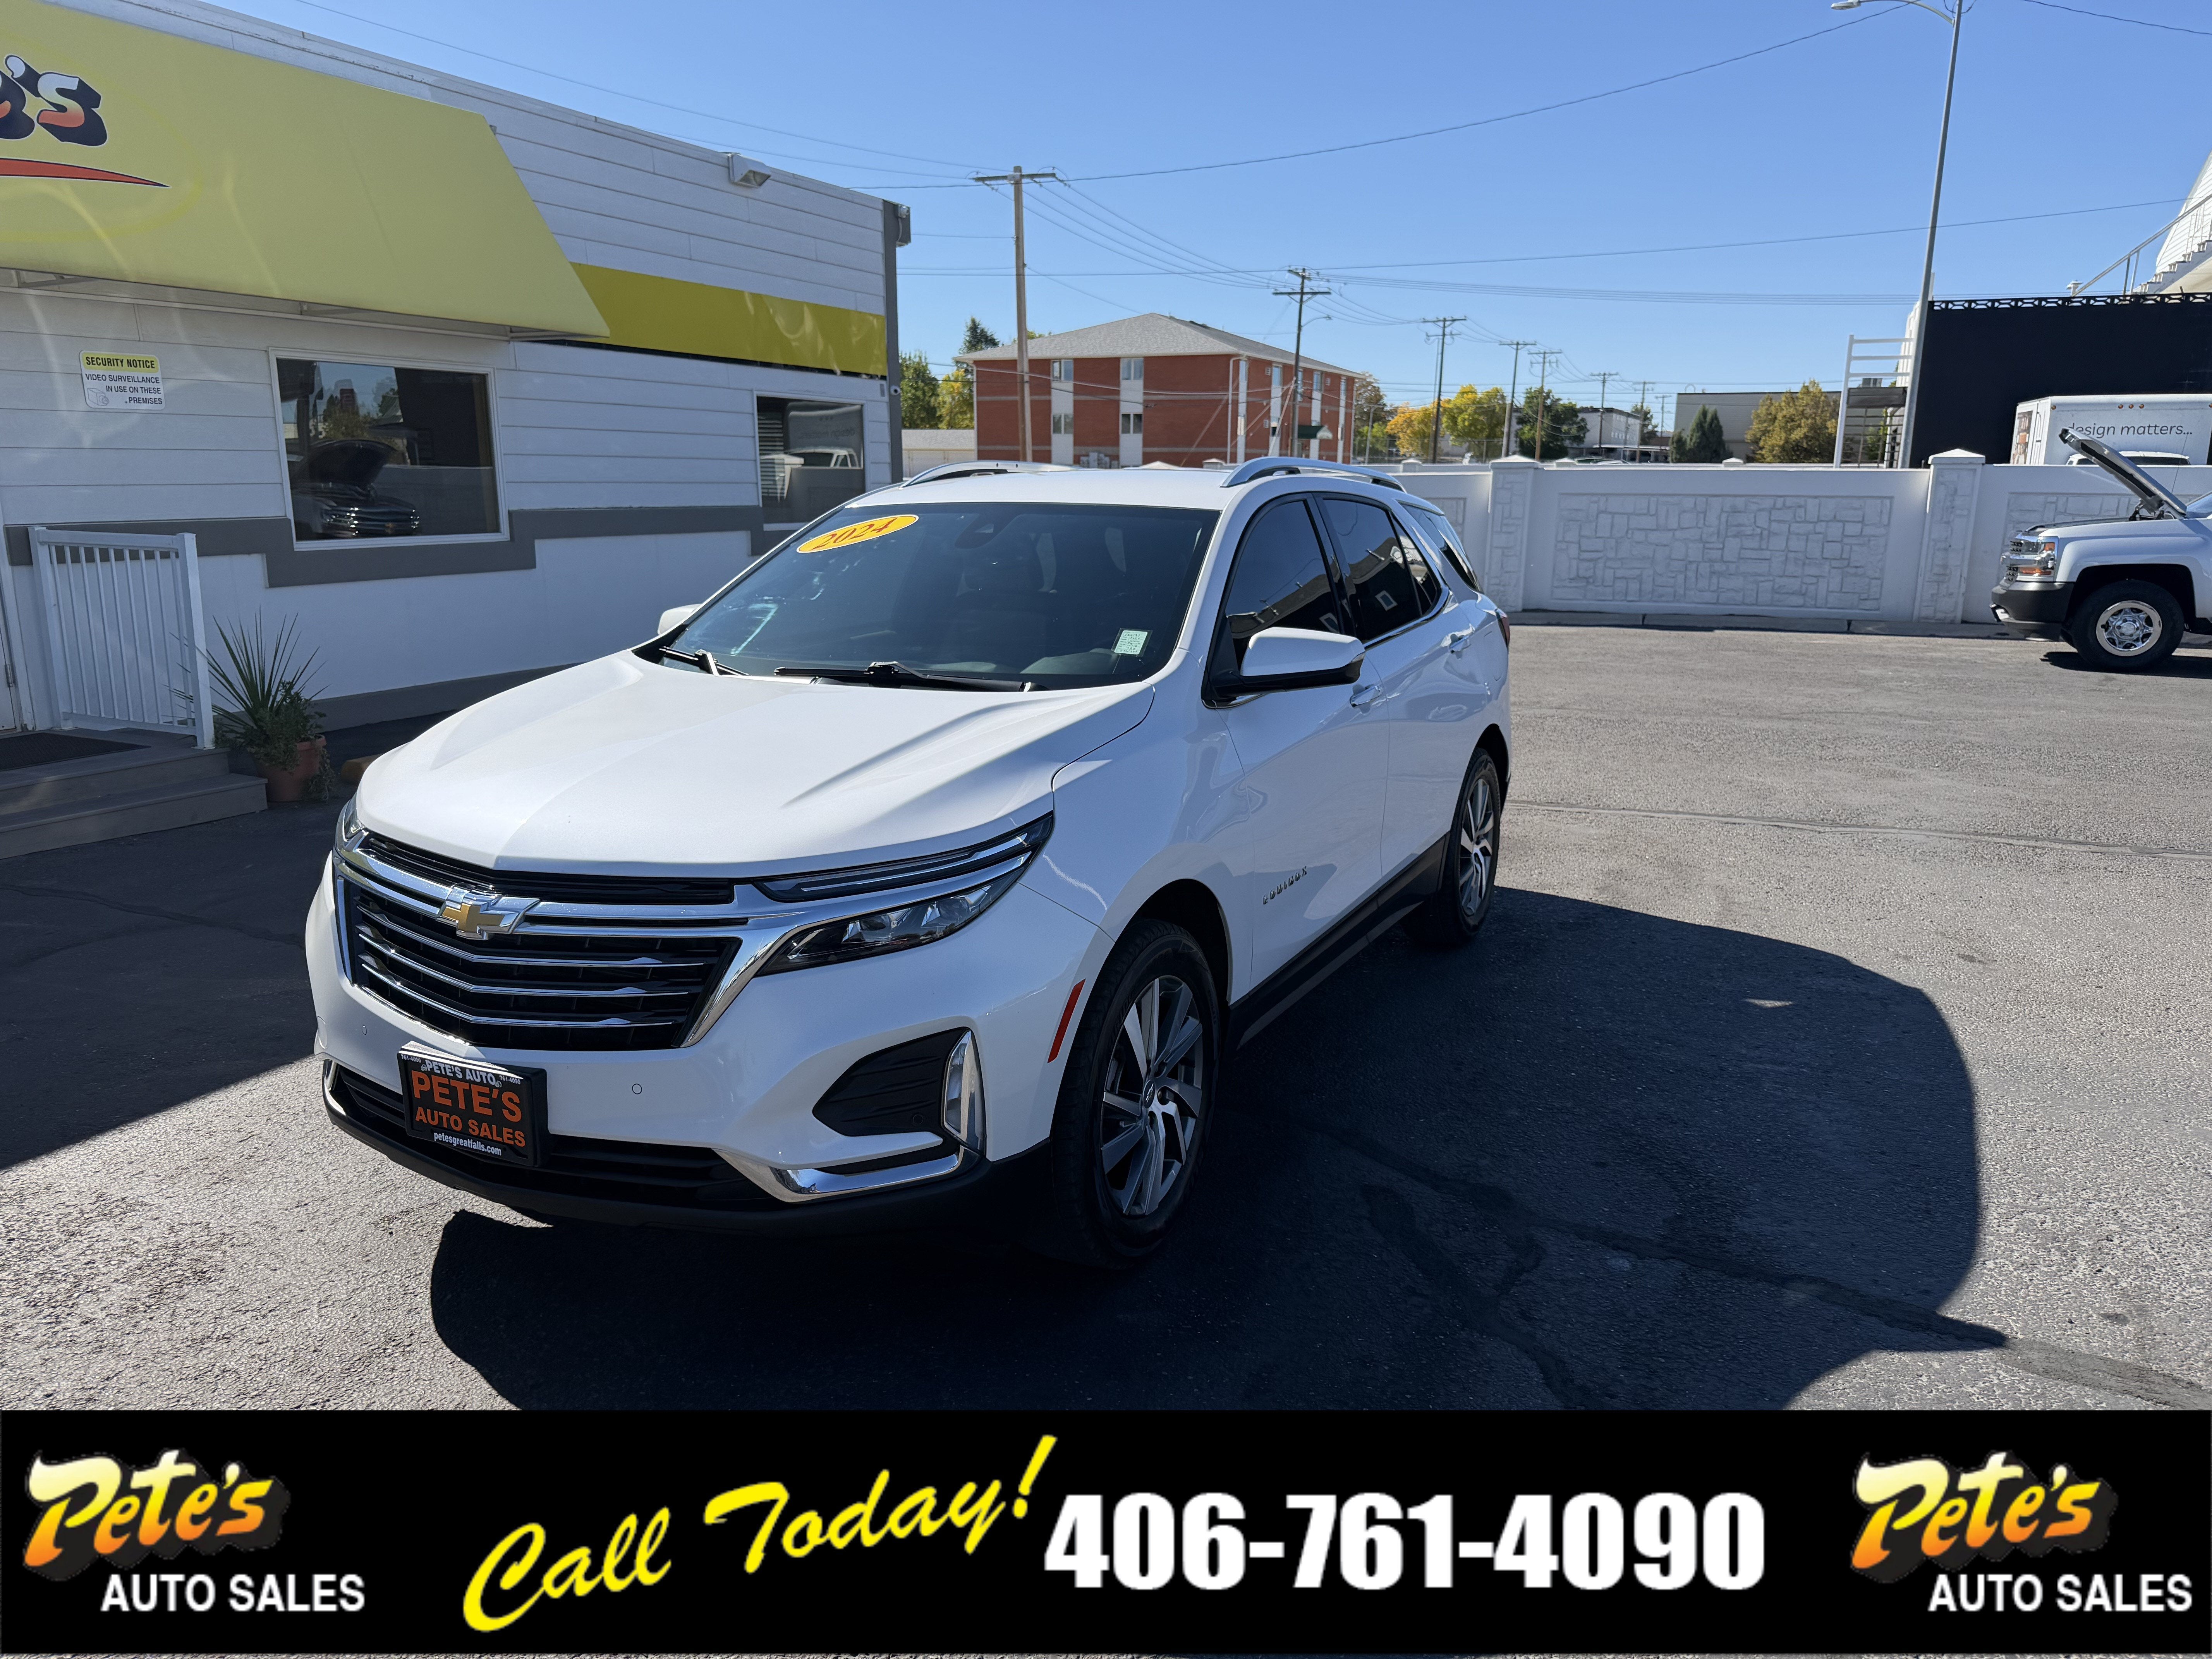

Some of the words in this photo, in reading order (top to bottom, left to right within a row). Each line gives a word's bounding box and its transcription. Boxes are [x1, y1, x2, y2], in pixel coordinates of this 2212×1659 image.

[86, 356, 124, 367] SECURITY
[127, 359, 155, 369] NOTICE
[108, 374, 160, 384] SURVEILLANCE
[812, 517, 898, 550] 2024
[1263, 866, 1307, 905] EQUINOX
[400, 1054, 421, 1063] 761-4090
[425, 1060, 463, 1079] PETE'S
[466, 1070, 496, 1085] AUTO
[499, 1075, 521, 1085] 761-4090
[411, 1070, 522, 1122] PETE'S
[415, 1107, 462, 1132] AUTO
[468, 1119, 526, 1147] SALES
[434, 1132, 502, 1156] petesgreatfalls.com
